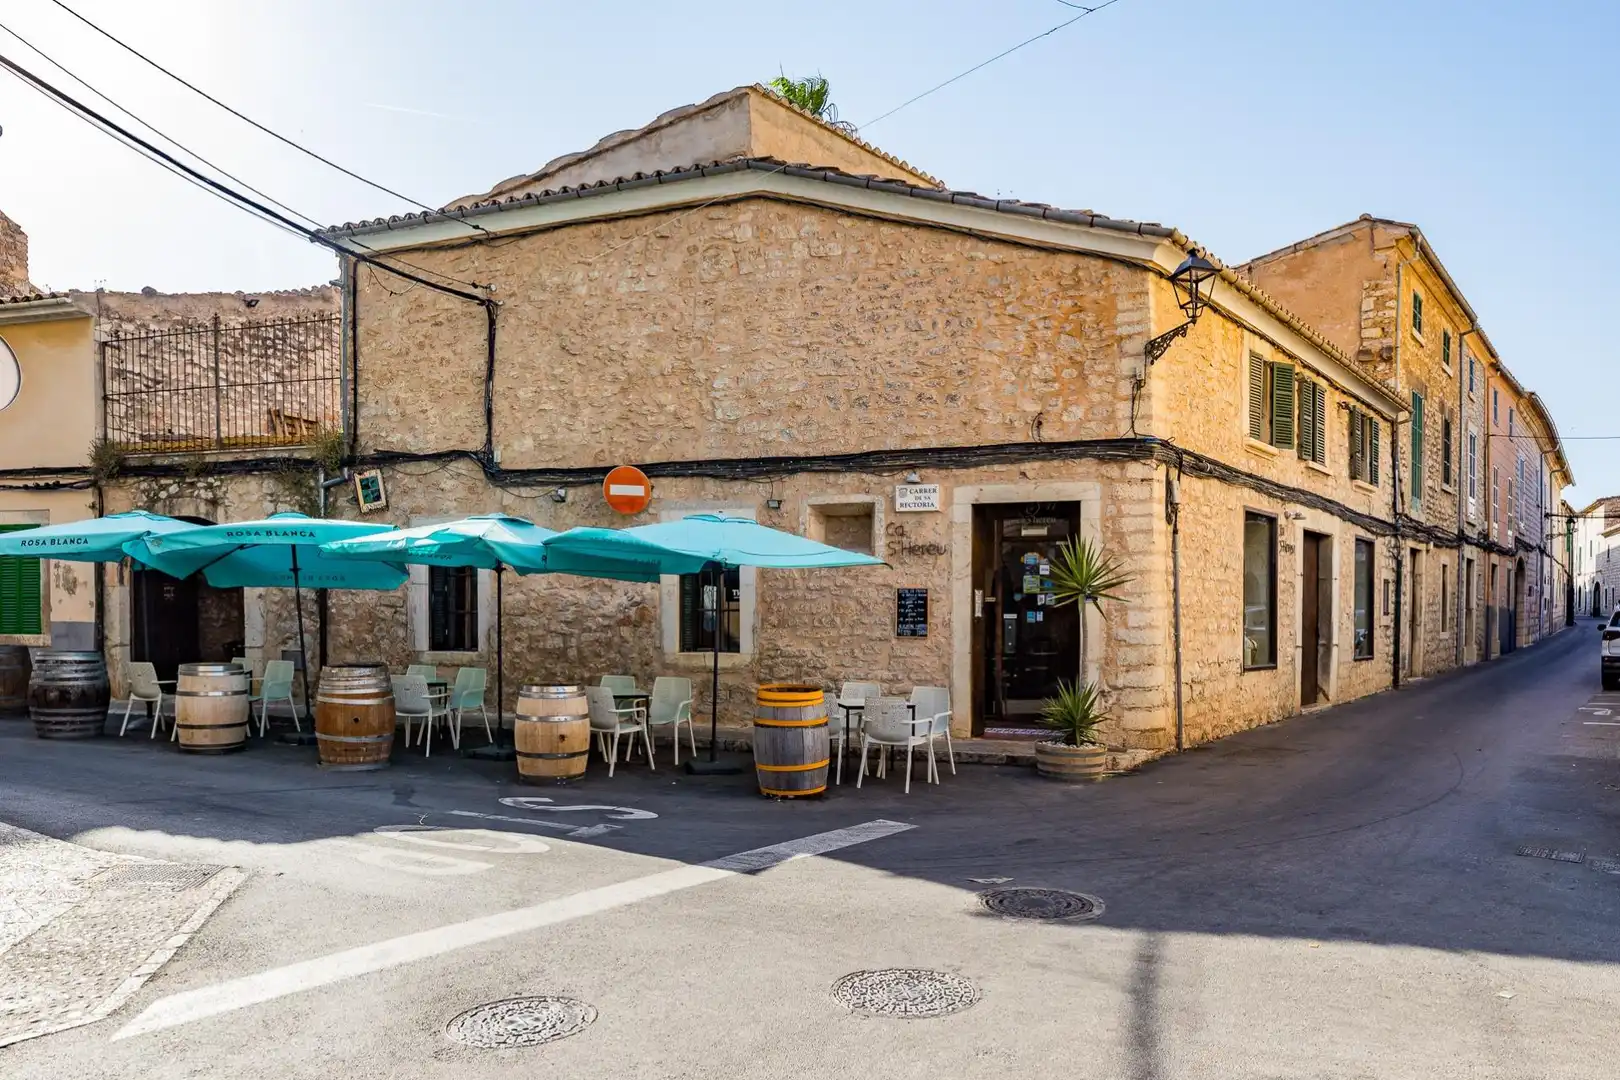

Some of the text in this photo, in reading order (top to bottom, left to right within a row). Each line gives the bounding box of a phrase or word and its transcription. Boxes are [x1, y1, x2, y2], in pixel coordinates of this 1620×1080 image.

[265, 530, 316, 538] BLANCA
[886, 522, 906, 537] Ca
[20, 537, 89, 547] ROSA BLANCA
